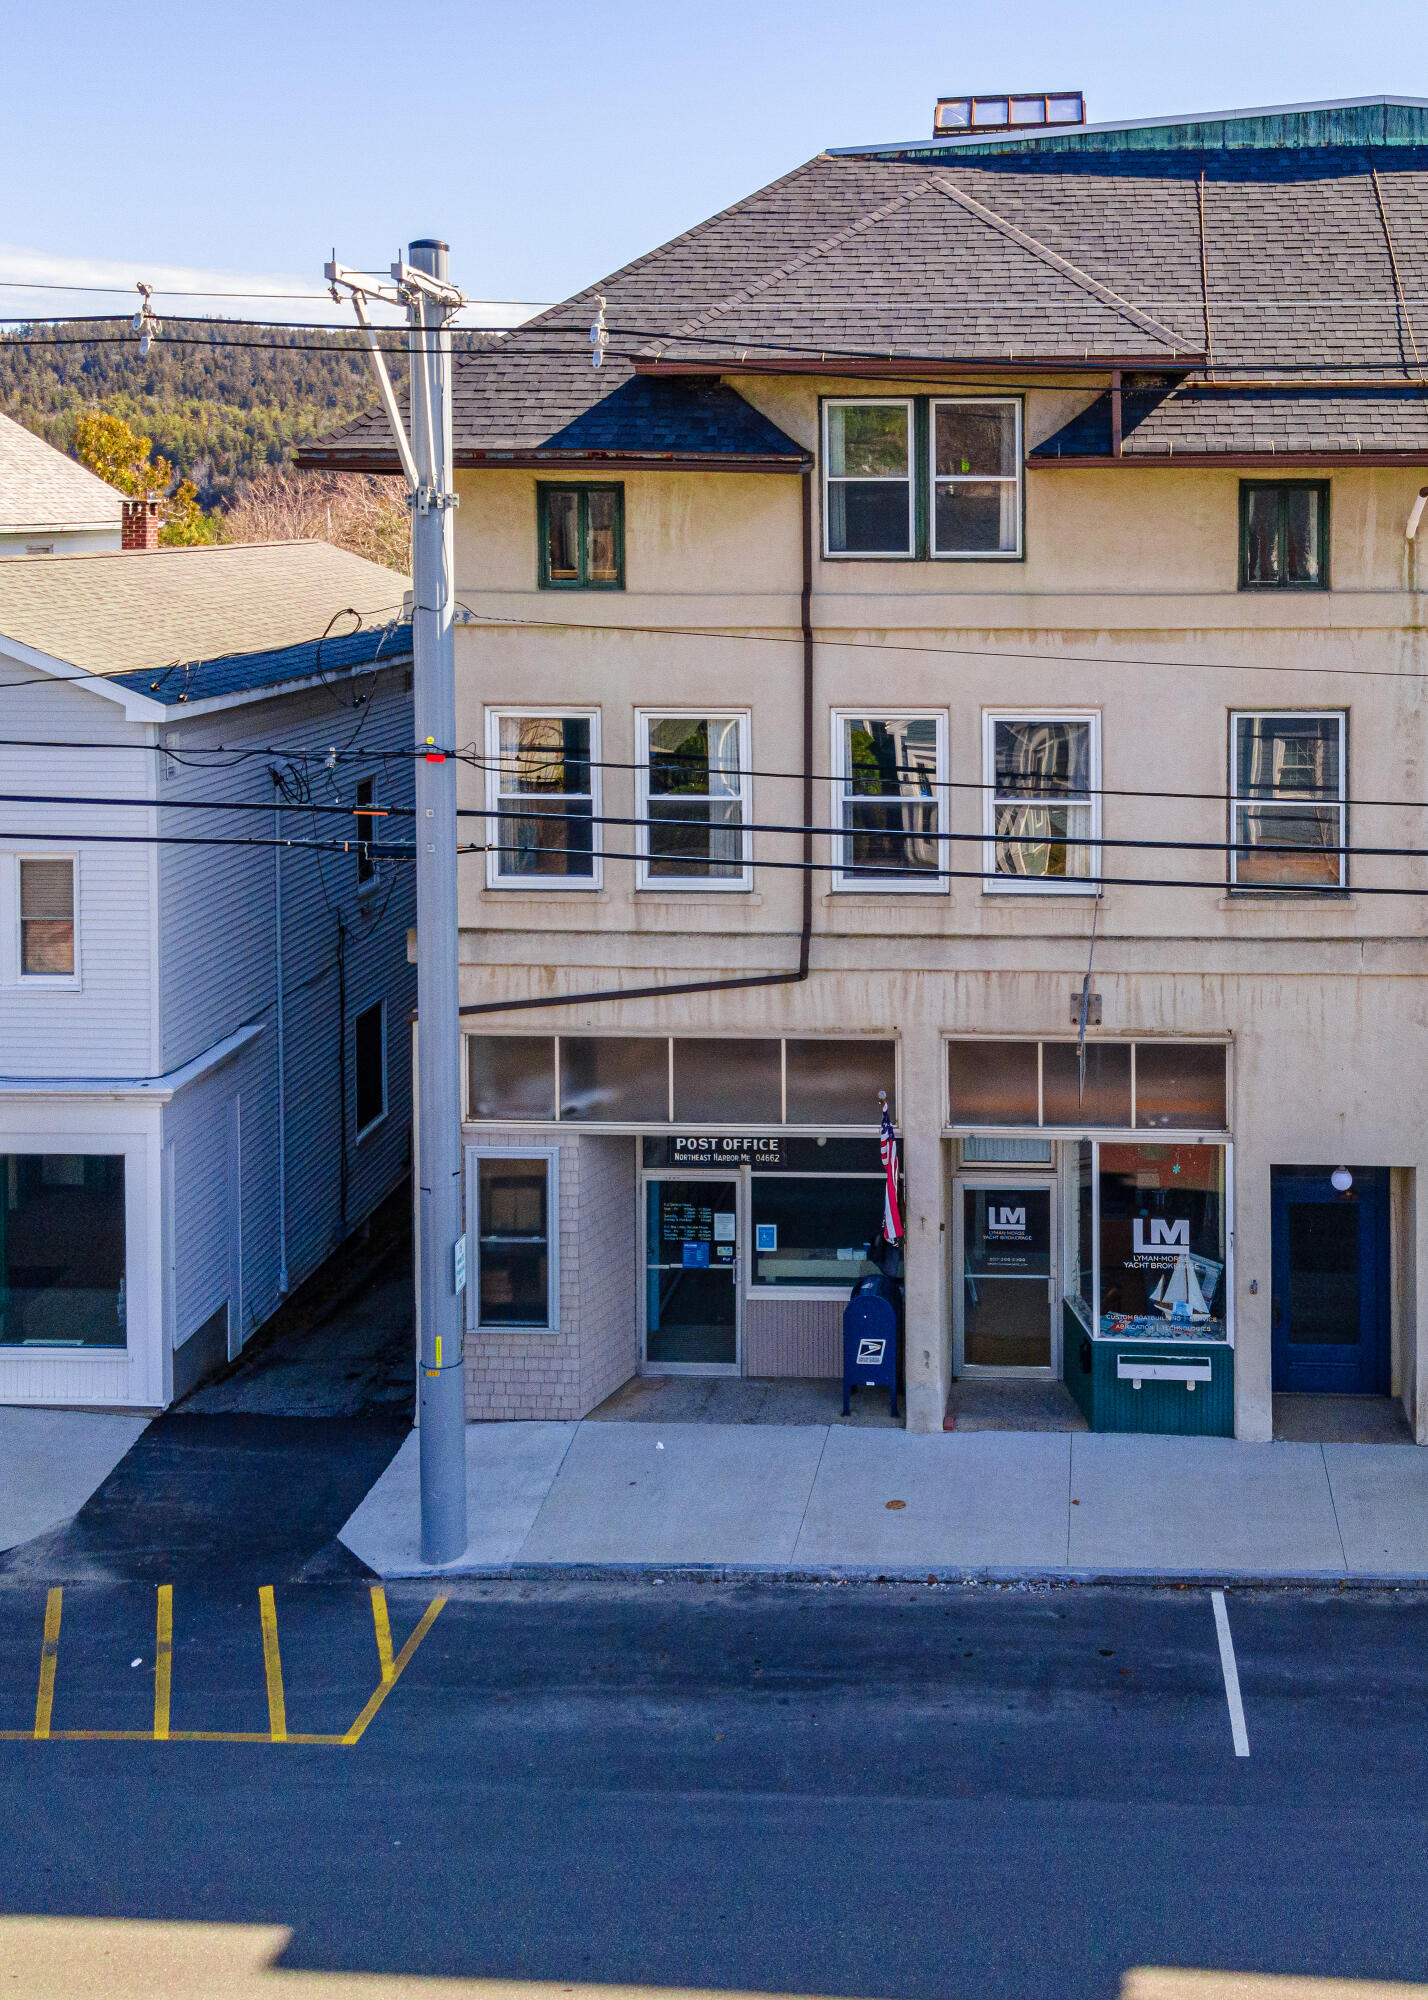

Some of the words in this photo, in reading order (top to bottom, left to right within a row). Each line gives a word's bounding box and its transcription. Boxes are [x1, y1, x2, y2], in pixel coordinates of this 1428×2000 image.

[676, 1138, 718, 1150] POST
[722, 1139, 779, 1151] OFFICE
[755, 1154, 780, 1163] 04662
[988, 1206, 1026, 1230] LM
[1133, 1218, 1190, 1254] LM
[1133, 1254, 1189, 1263] LYMAN-MOR
[1123, 1261, 1149, 1269] YACHT
